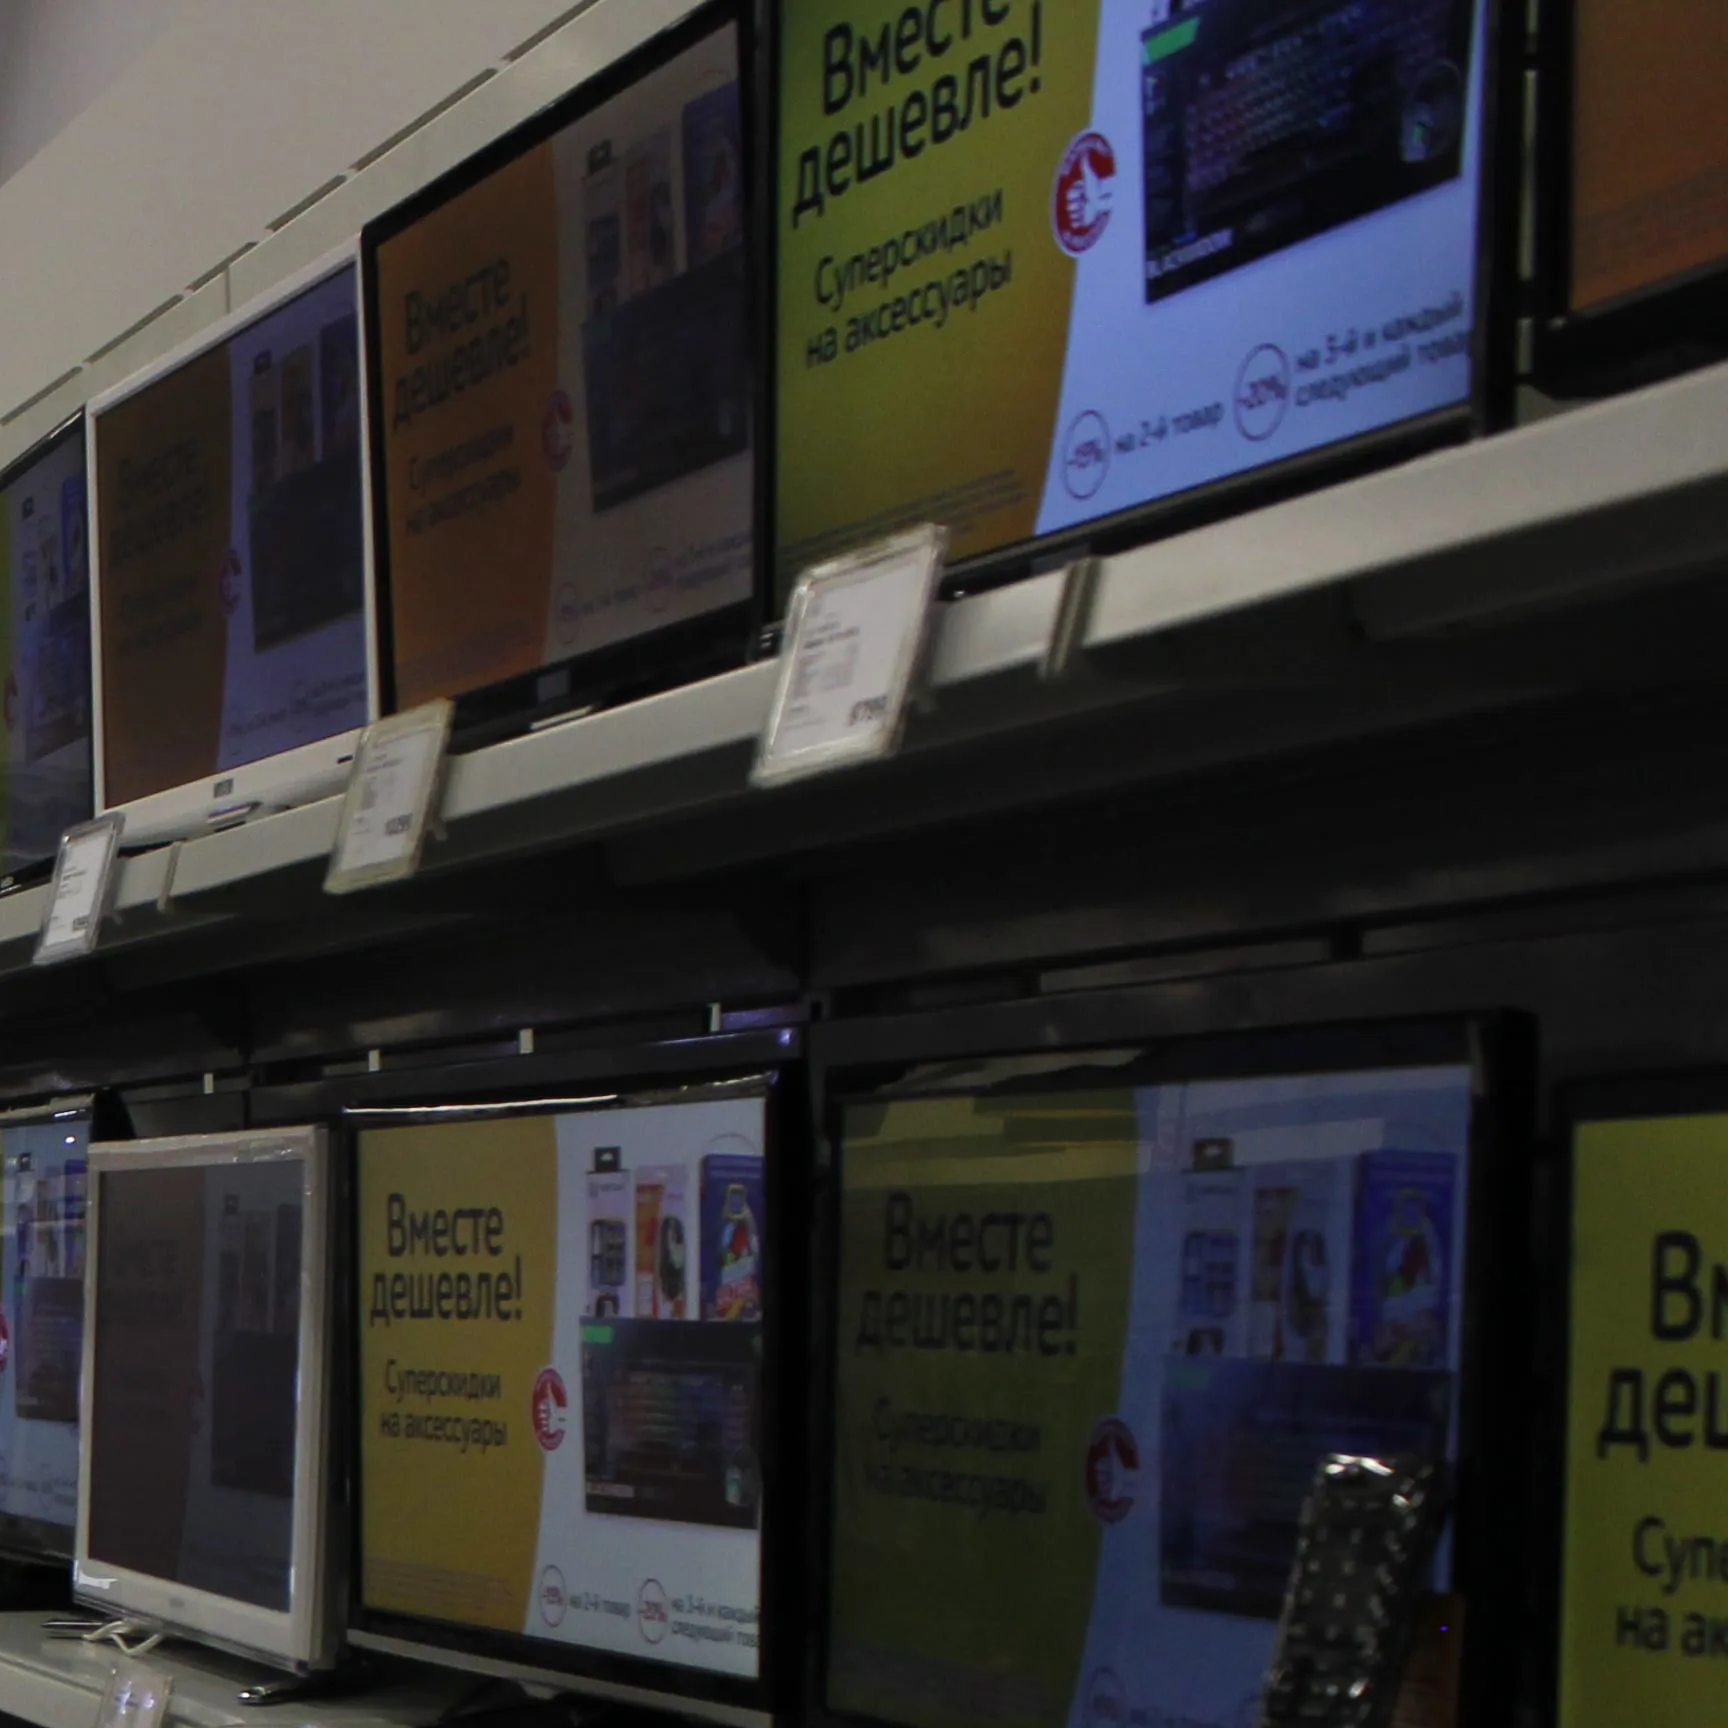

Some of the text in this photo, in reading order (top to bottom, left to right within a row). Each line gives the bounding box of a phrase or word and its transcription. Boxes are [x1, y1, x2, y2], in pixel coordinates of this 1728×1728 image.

[822, 0, 1012, 117] Вмес
[792, 0, 1042, 230] дешевле!
[814, 189, 1004, 313] Суперскидки
[404, 255, 511, 356] Вместе
[805, 250, 1013, 370] на аксессуары
[393, 292, 532, 433] дешевле!
[387, 1193, 504, 1257] Вместе
[884, 1190, 1055, 1273] Вместе
[370, 1256, 523, 1328] дешевле!
[855, 1272, 1078, 1358] дешевле!
[385, 1359, 502, 1403] Суперскидки
[381, 1412, 508, 1454] на аксессуары
[1616, 1602, 1670, 1652] на
